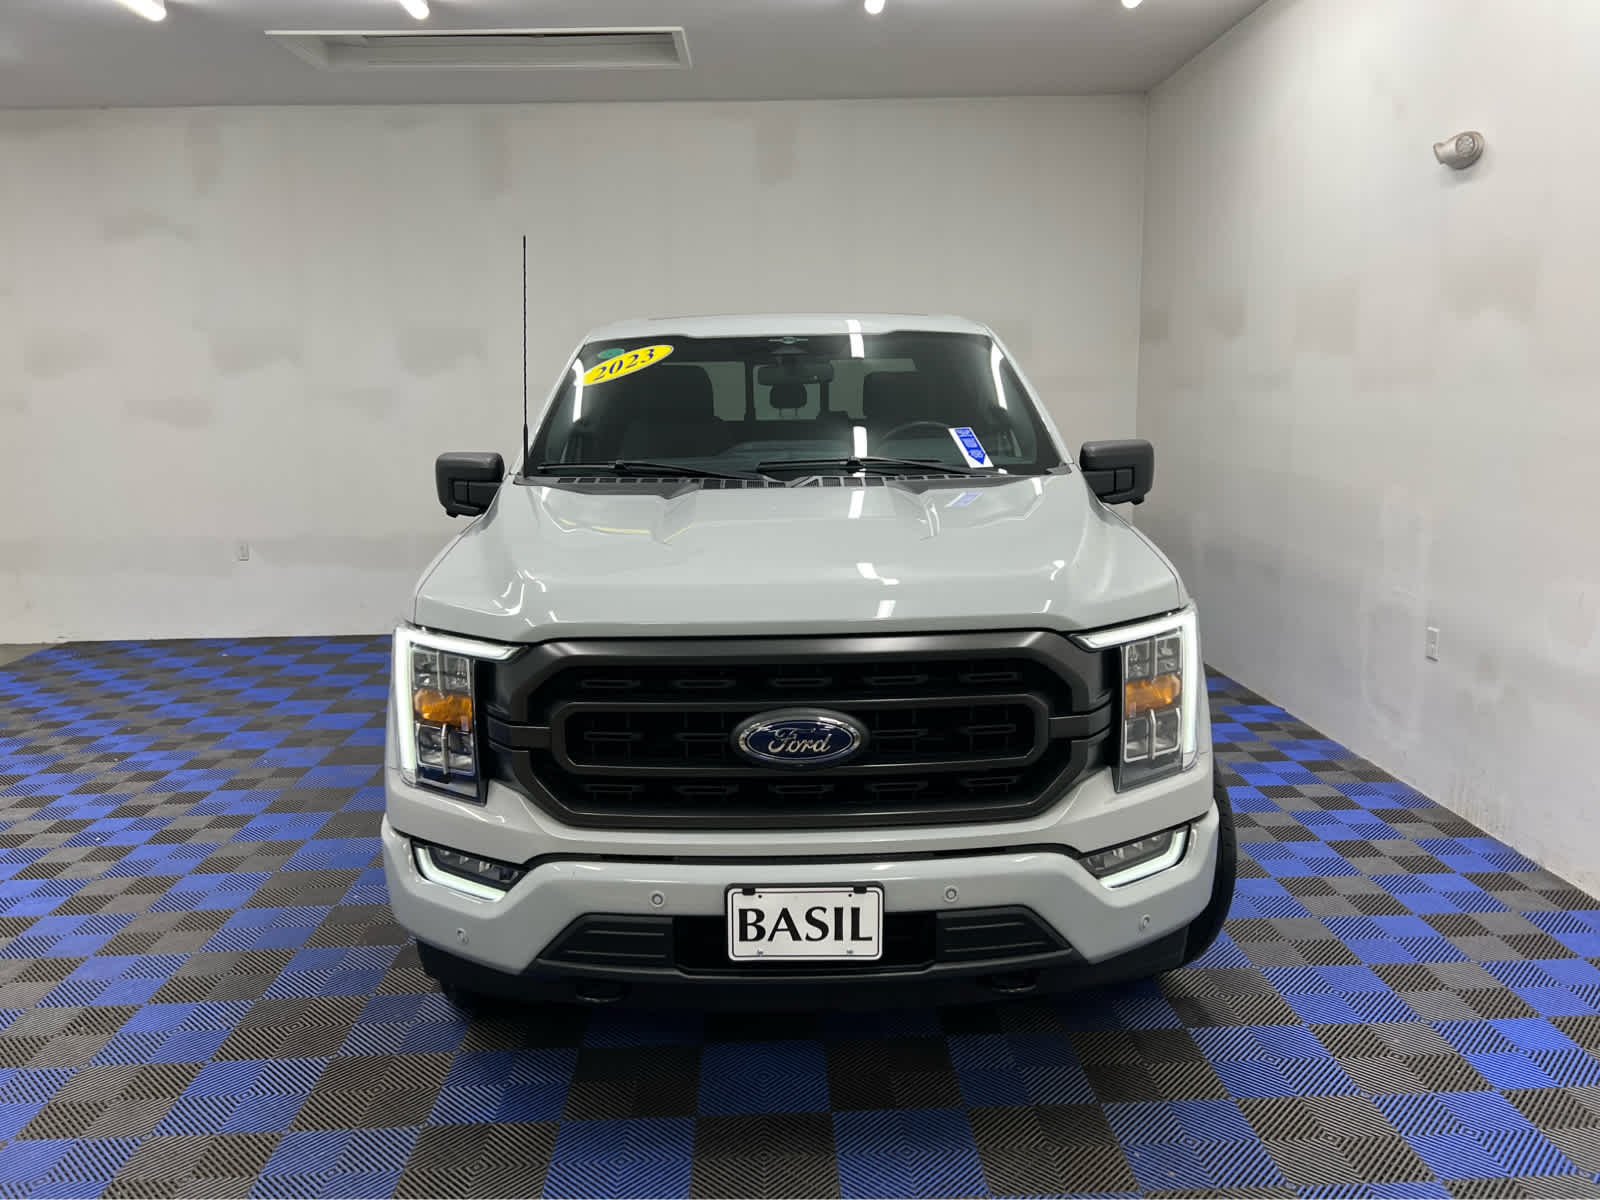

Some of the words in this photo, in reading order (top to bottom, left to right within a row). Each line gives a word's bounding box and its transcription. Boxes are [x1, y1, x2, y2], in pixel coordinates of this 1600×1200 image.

[594, 348, 654, 381] 2023
[767, 727, 833, 753] Ford
[738, 906, 873, 942] BASIL
